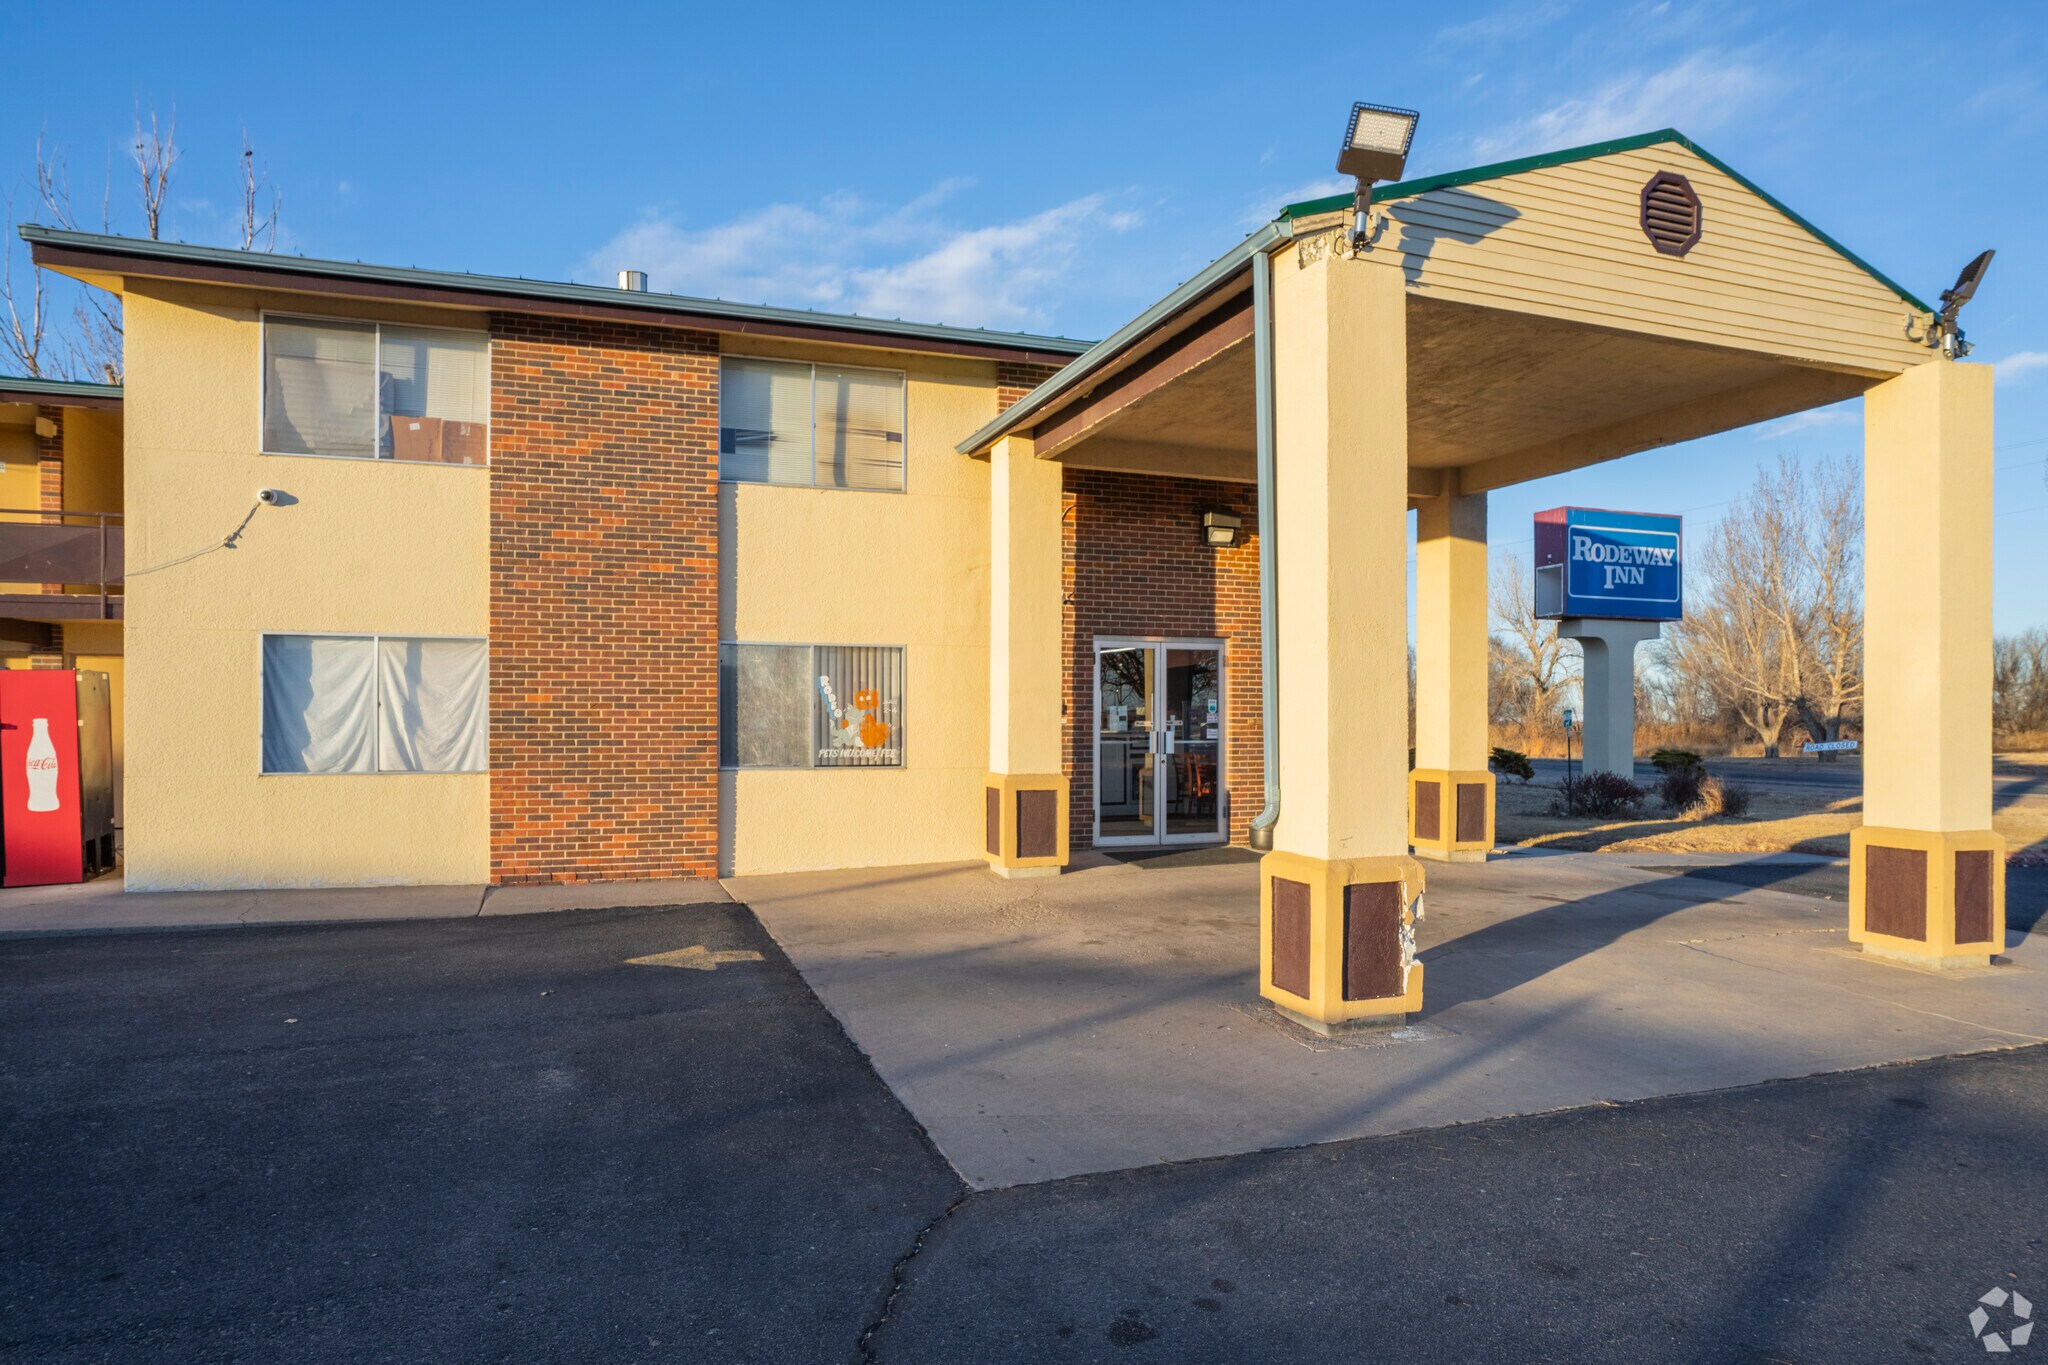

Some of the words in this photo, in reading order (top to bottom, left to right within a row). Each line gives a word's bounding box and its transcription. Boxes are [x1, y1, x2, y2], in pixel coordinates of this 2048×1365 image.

[1572, 536, 1675, 566] RODEWAY
[1603, 565, 1645, 589] INN
[1827, 741, 1855, 749] CLOSED
[818, 749, 839, 758] PETS
[28, 757, 57, 770] oca-Cola
